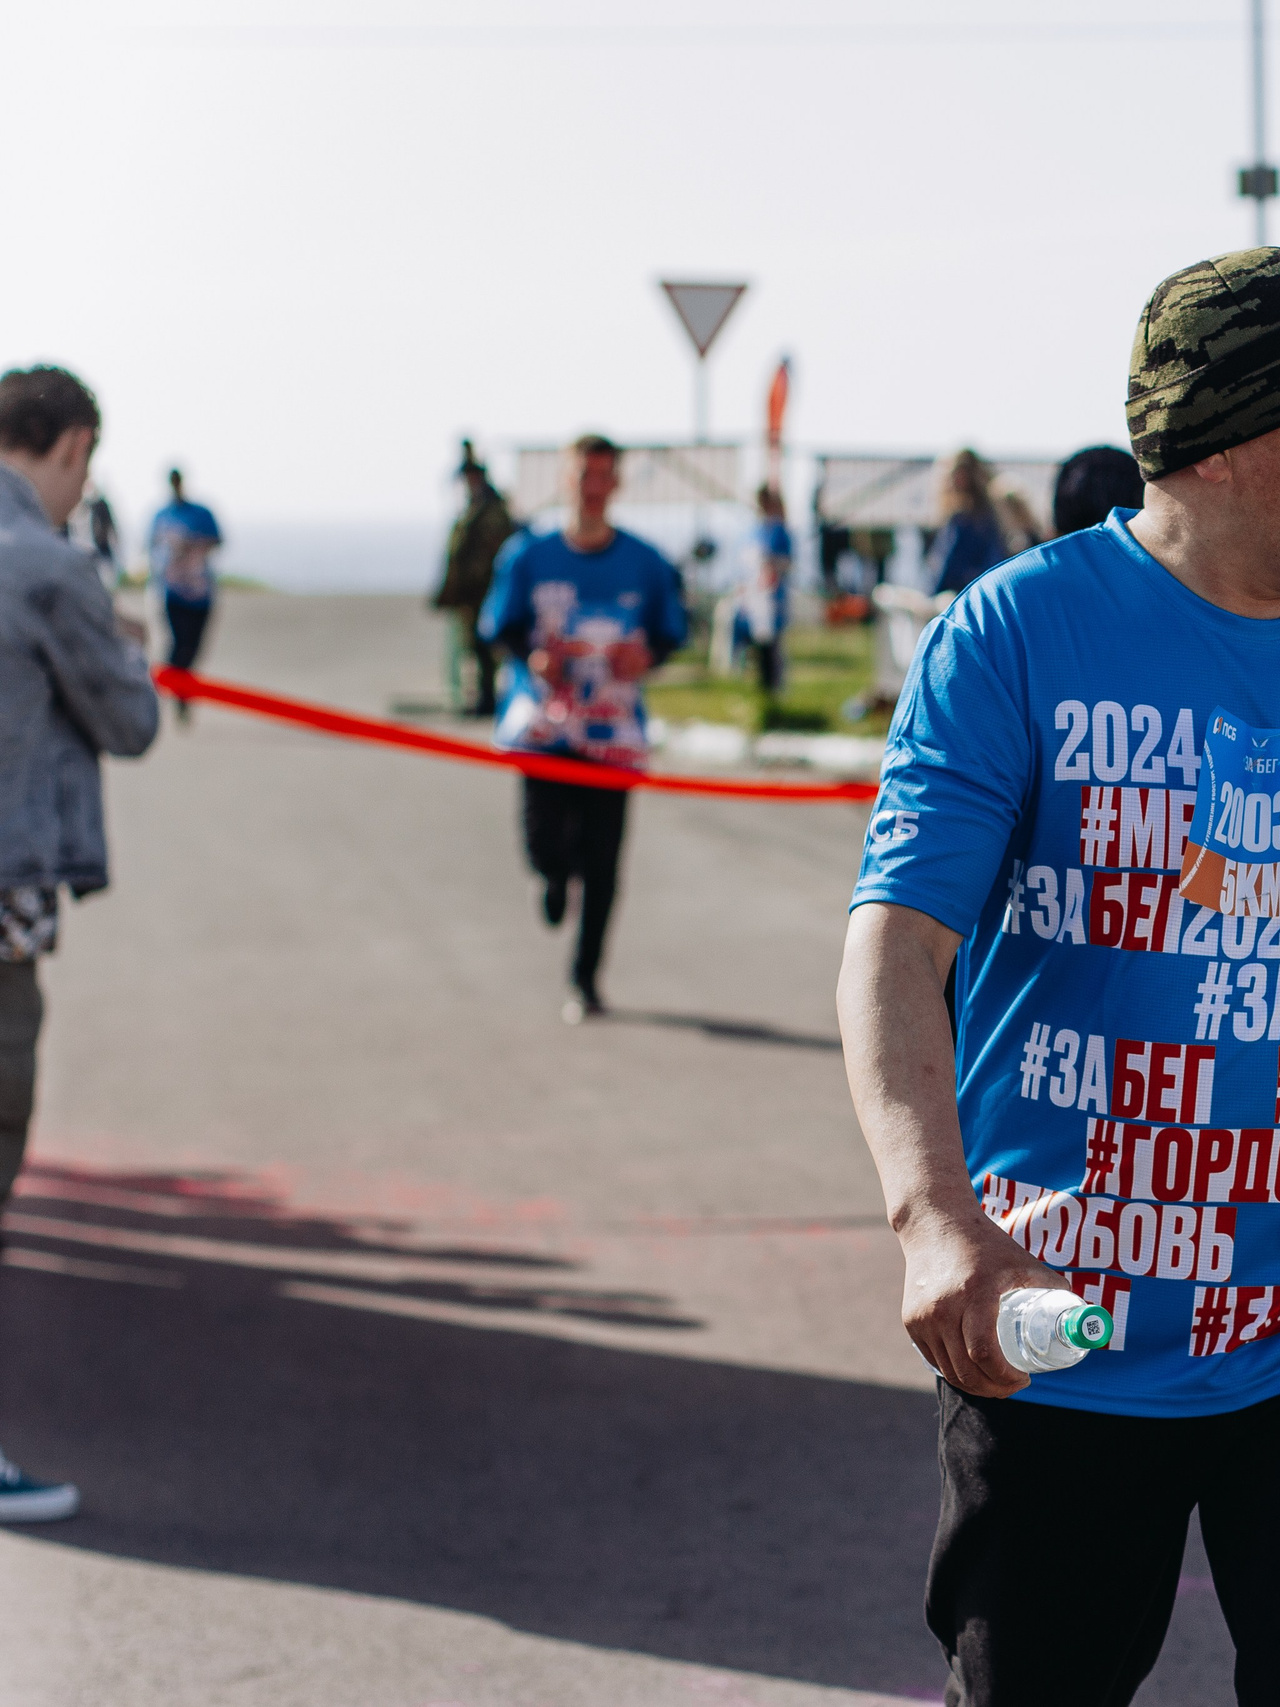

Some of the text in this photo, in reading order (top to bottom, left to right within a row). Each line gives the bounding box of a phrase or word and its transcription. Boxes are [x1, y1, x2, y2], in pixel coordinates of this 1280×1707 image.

[1054, 699, 1200, 785] 2024
[1221, 721, 1237, 742] ПСБ
[870, 809, 920, 842] СБ
[1080, 786, 1197, 869] #МЕ
[1019, 1022, 1215, 1124] #ЗАБЕГ
[981, 1173, 1236, 1283] #ЛЮБОВЬ
